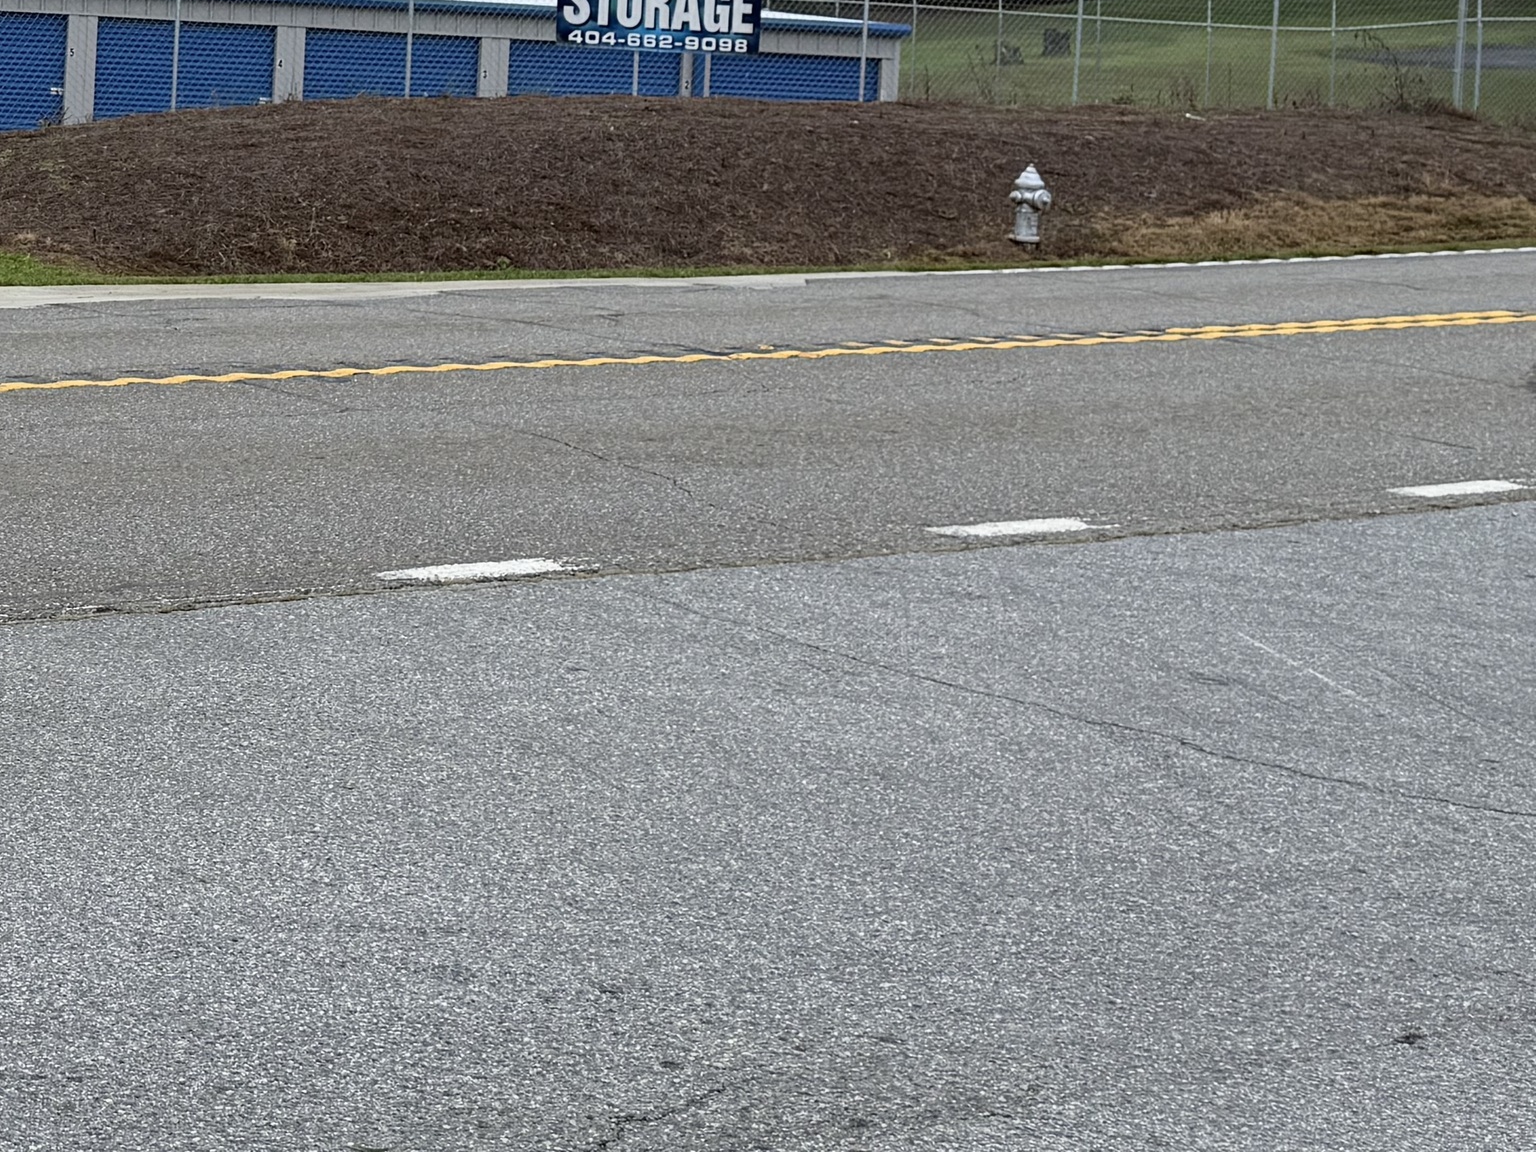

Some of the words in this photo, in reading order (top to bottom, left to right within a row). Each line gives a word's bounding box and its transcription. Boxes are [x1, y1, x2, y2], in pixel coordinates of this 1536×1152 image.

[567, 30, 748, 53] 404-662-9098
[69, 48, 75, 57] 5
[277, 59, 283, 68] 4
[482, 70, 488, 79] 3
[684, 81, 690, 90] 2
